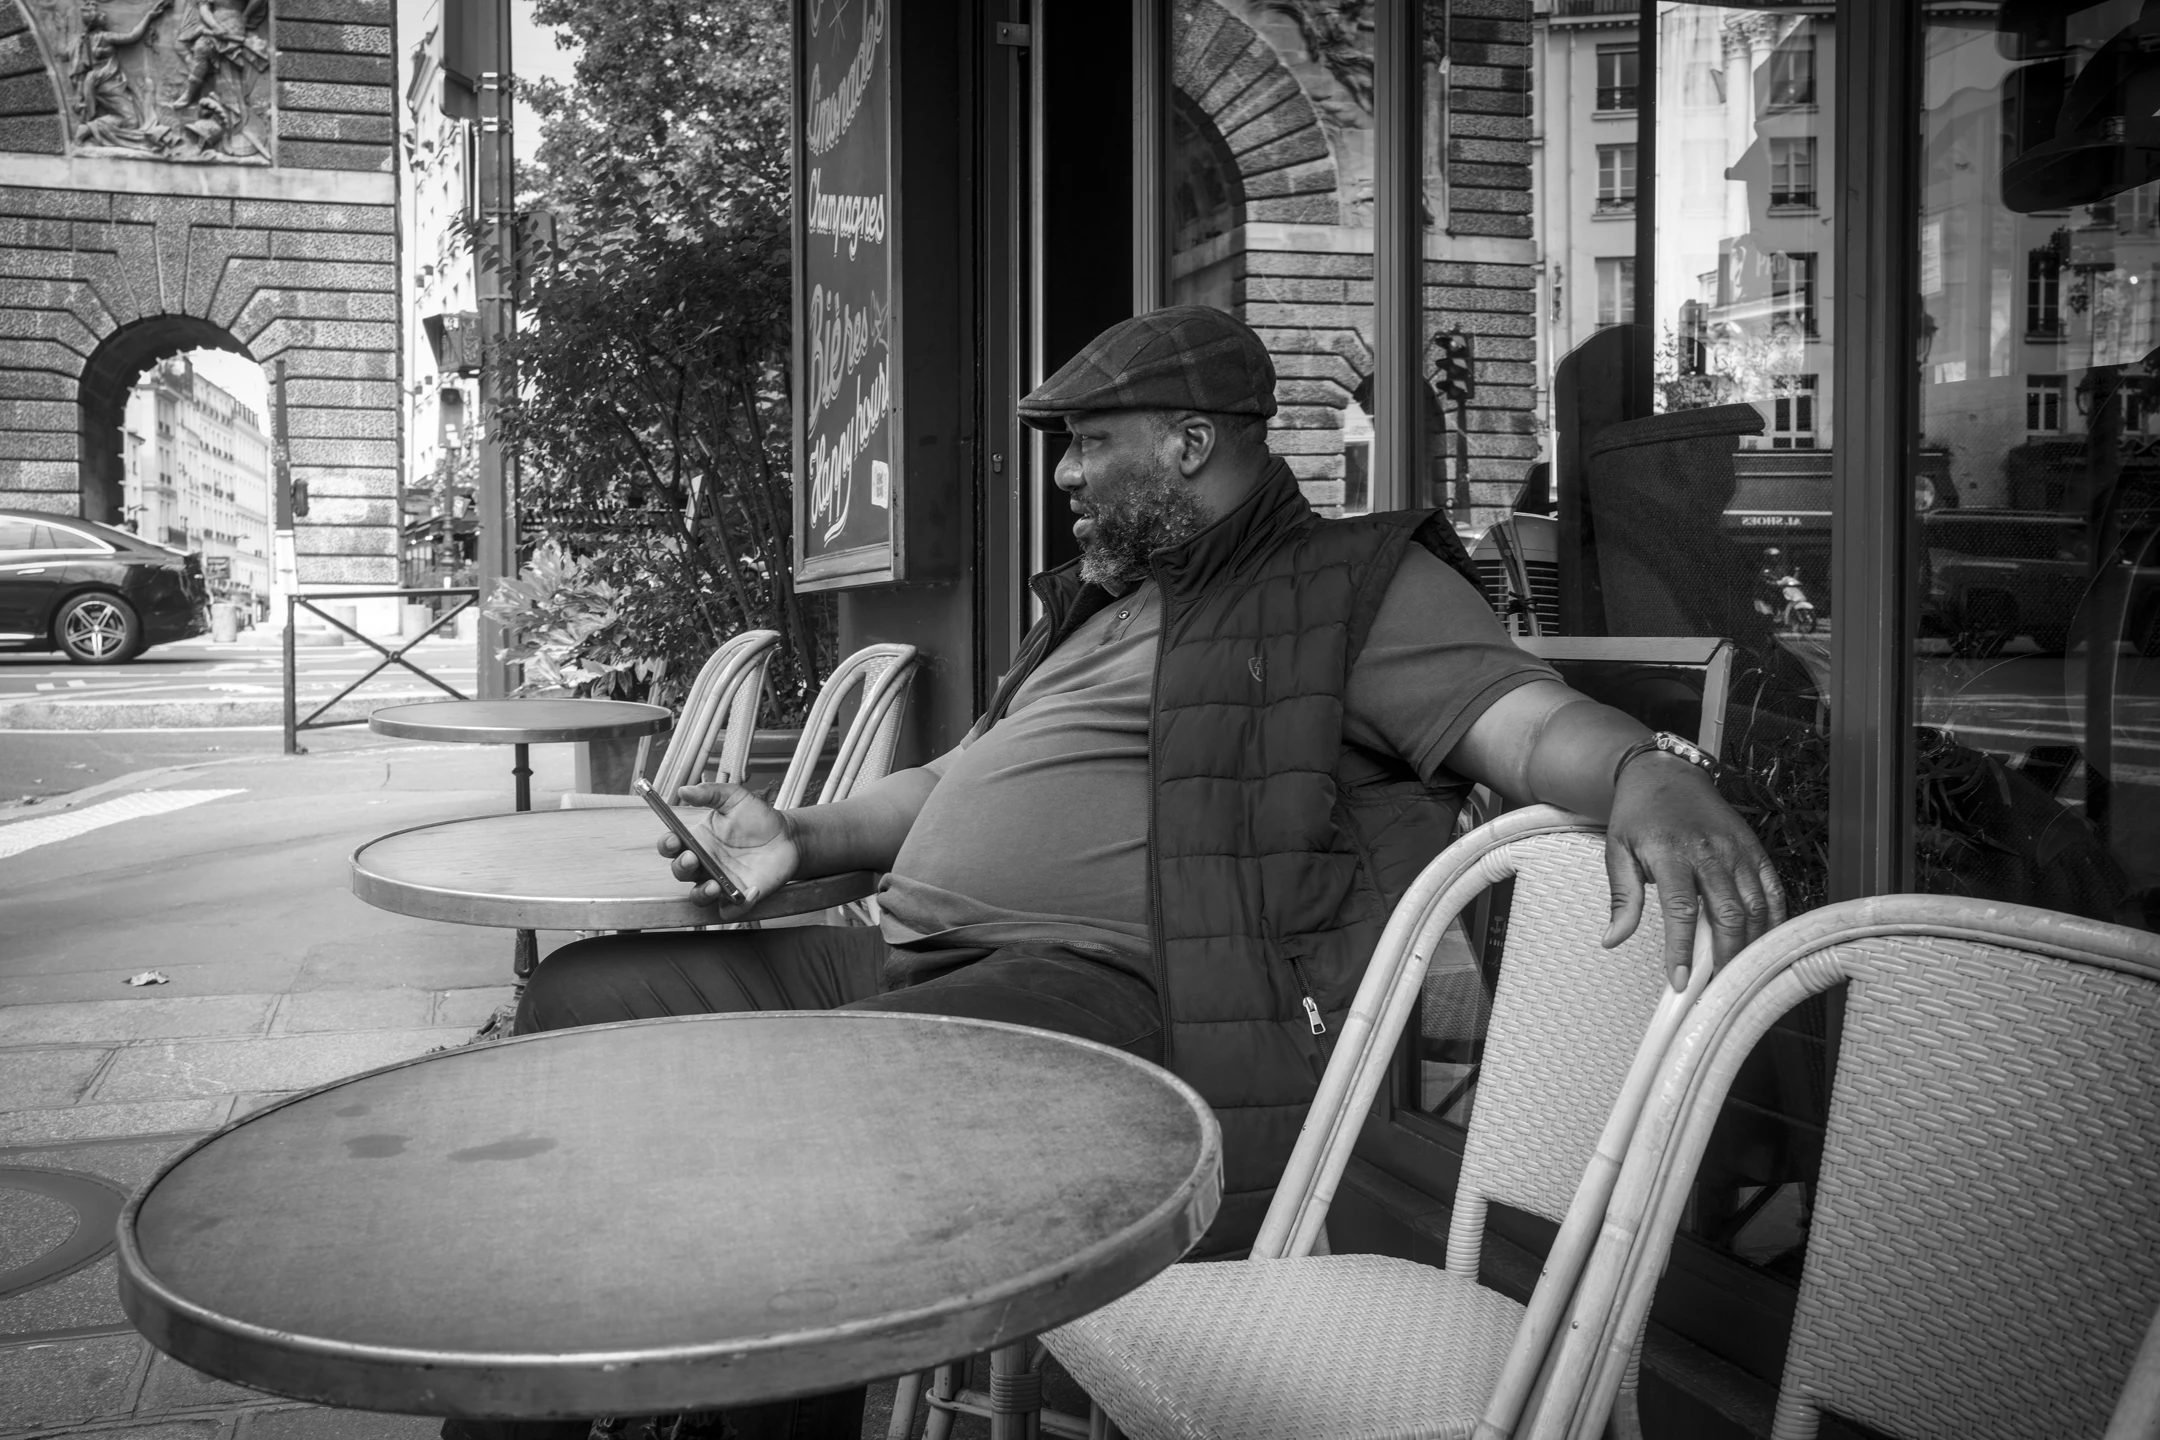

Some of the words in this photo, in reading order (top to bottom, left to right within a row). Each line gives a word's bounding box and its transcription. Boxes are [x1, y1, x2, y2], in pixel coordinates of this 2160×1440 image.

[808, 168, 885, 261] Champagnes
[808, 283, 868, 439] Bières
[809, 417, 855, 548] Happy
